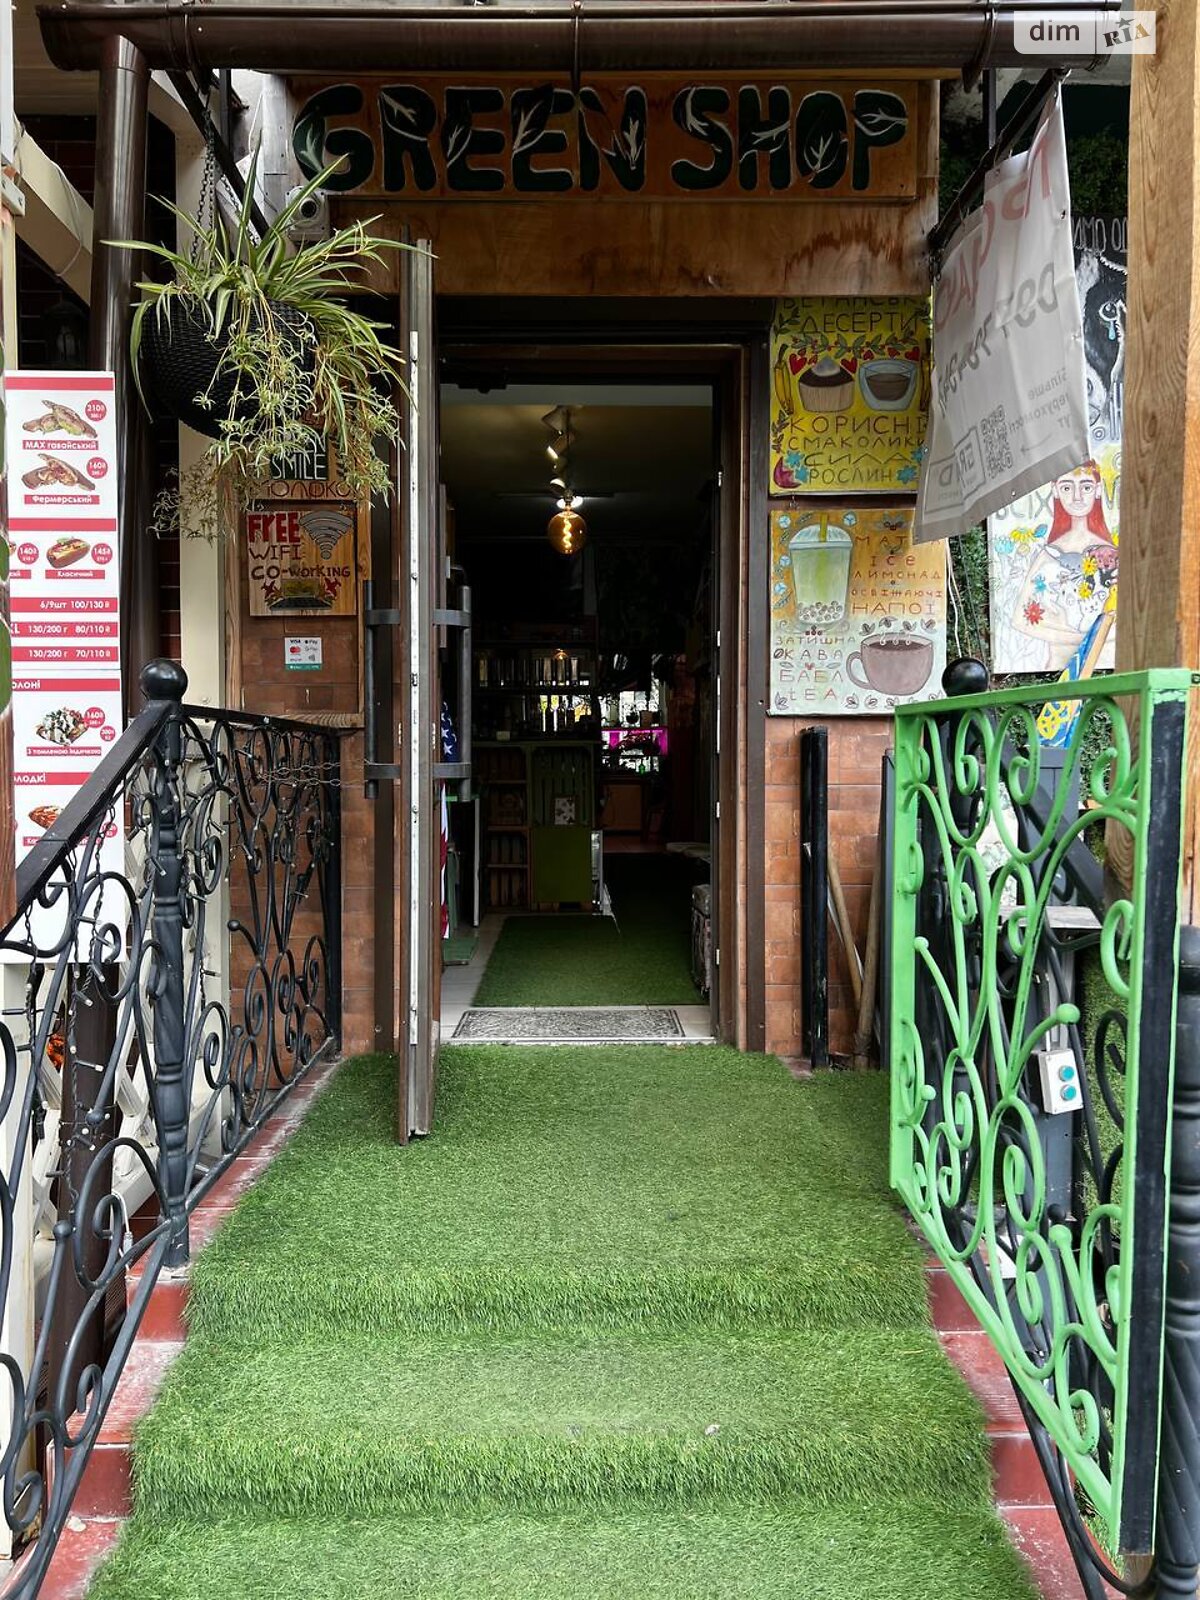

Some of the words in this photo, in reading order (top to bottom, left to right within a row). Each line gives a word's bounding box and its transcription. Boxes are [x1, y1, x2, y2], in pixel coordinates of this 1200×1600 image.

[292, 83, 647, 192] GREEN
[671, 84, 909, 192] SHOP
[801, 312, 918, 334] ДЕСЕРТИ
[790, 415, 928, 434] КОРИСНІ
[788, 436, 926, 451] СМАКОЛИКИ
[271, 453, 327, 480] SMILE
[803, 451, 913, 467] СИЛА
[809, 468, 893, 485] РОСЛИН
[31, 494, 93, 506] Фермерський
[248, 512, 301, 544] FREE
[249, 545, 302, 561] WIFI
[854, 570, 942, 580] ЛИМОНАД
[851, 588, 944, 598] ОСВІЖАЮЧІ
[775, 635, 856, 646] ЗАТИШНА
[784, 649, 843, 661] КАВА
[779, 669, 844, 683] БАБЛ
